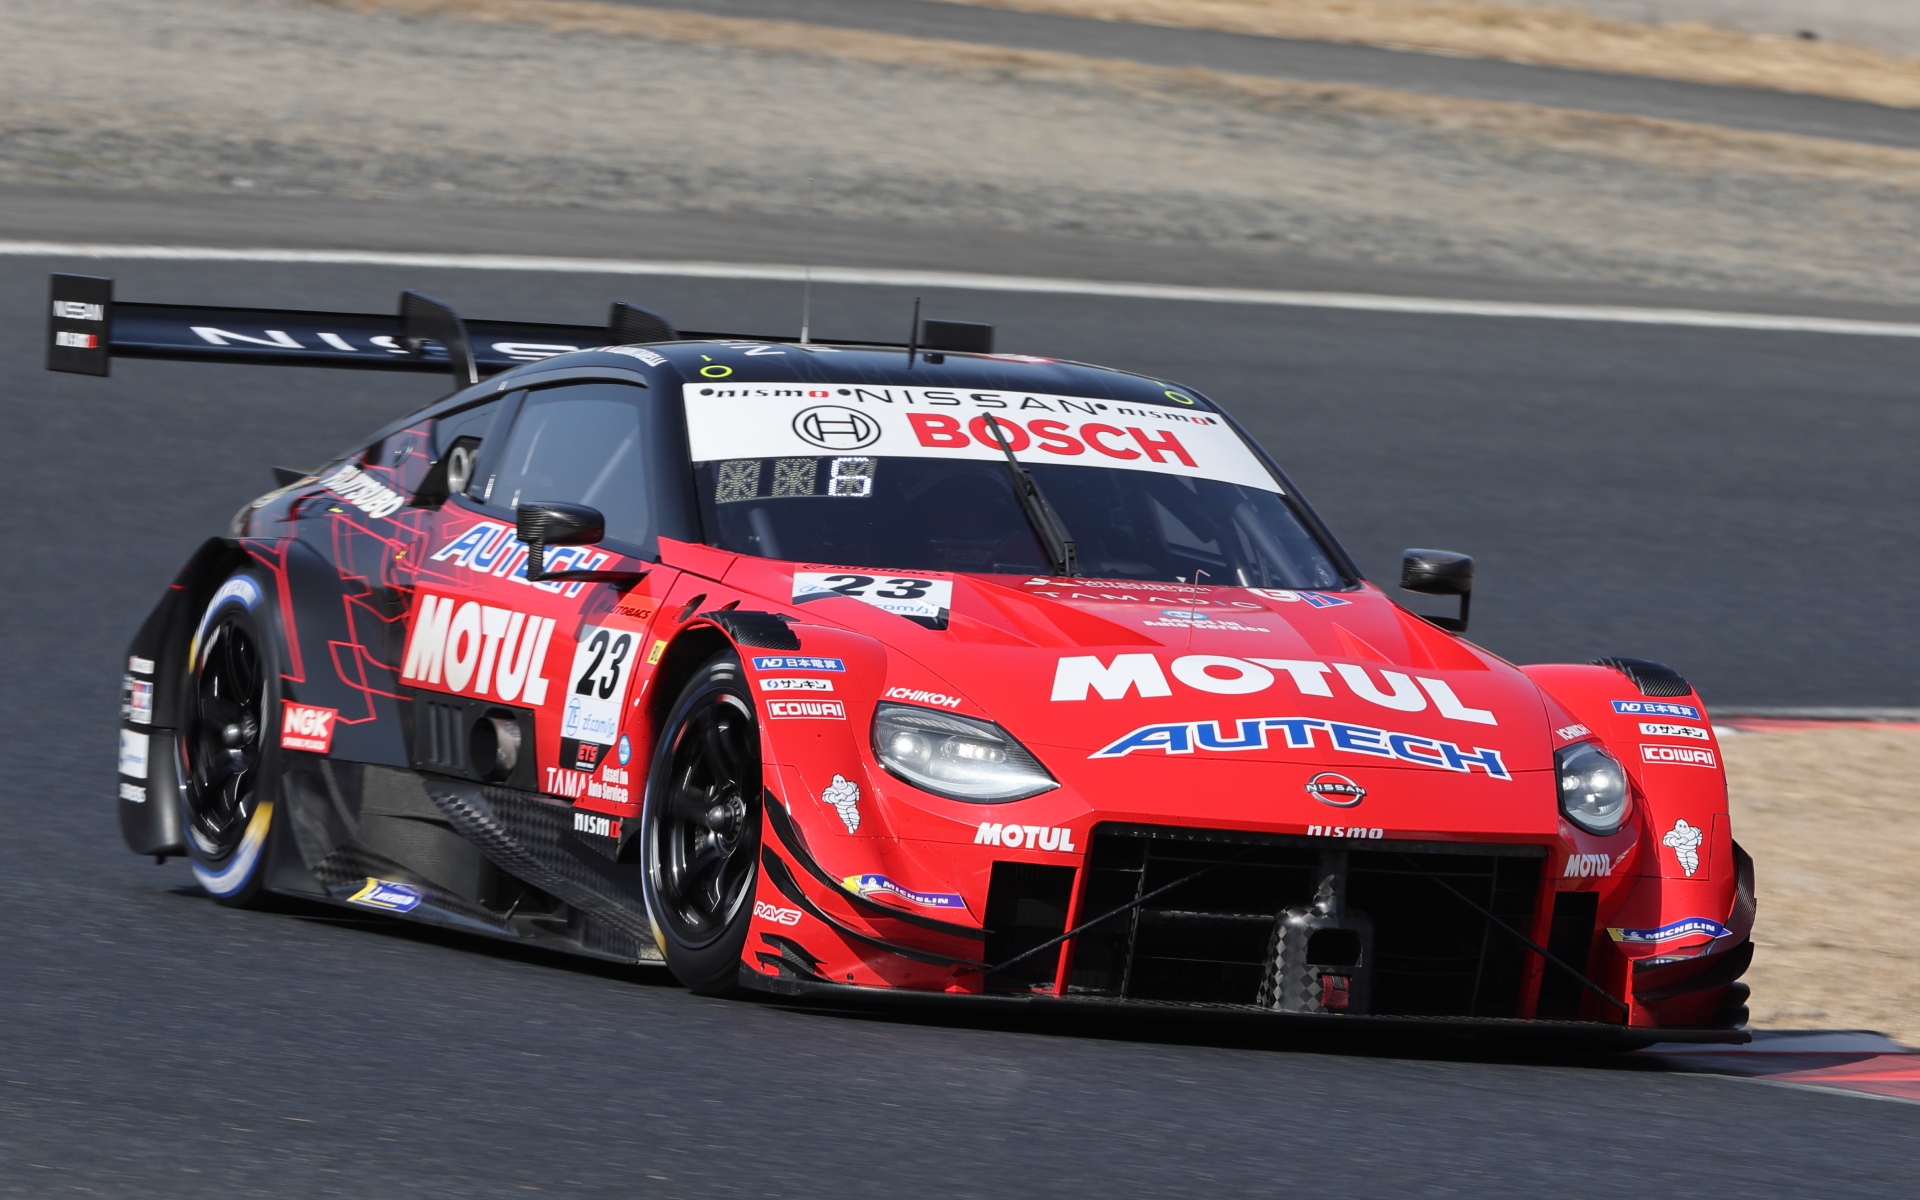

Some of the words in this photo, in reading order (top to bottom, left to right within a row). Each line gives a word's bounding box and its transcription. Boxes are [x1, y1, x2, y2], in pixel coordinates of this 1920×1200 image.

[717, 389, 829, 398] nismo
[855, 388, 1098, 415] NISSAN
[1117, 407, 1210, 426] nismo
[905, 412, 1199, 468] BOSCH
[823, 574, 933, 599] 23
[402, 594, 556, 706] MOTUL
[575, 630, 632, 699] 23
[780, 680, 826, 690] サンキン
[1050, 653, 1498, 726] MOTUL
[885, 687, 962, 708] ICHIKOH
[770, 703, 843, 717] KOIWAI
[284, 707, 333, 738] NGK
[1659, 726, 1703, 738] サンキン
[1087, 717, 1513, 781] AUTECH
[1643, 747, 1713, 765] KOIWAI
[1306, 783, 1366, 795] NISSAN
[574, 812, 620, 838] nismo
[974, 822, 1074, 851] MOTUL
[1307, 825, 1384, 839] nismo
[1563, 854, 1612, 877] MOTUL
[882, 880, 949, 904] MICHELIN
[754, 900, 802, 926] RAYS
[1645, 922, 1715, 939] MICHELIN
